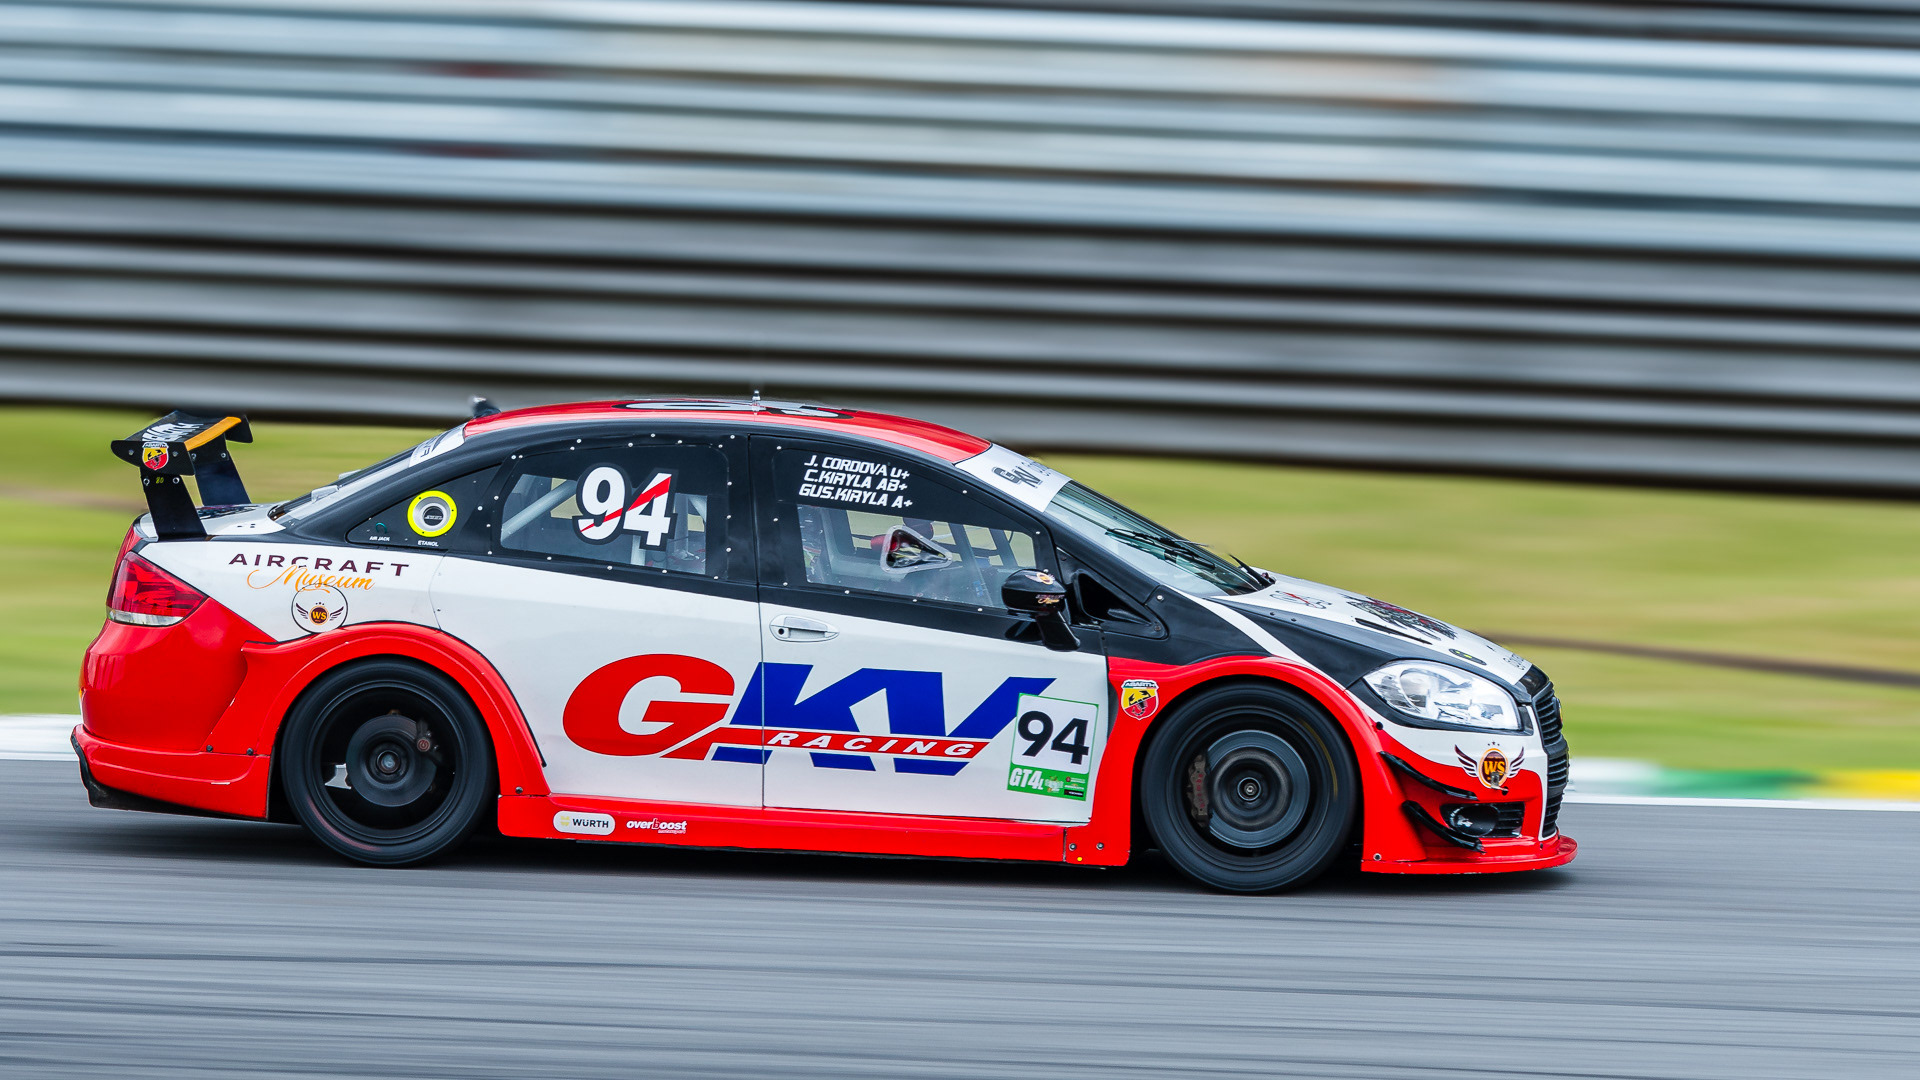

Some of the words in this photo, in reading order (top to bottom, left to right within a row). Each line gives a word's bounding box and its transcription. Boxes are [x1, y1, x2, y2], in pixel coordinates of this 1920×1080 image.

[804, 454, 819, 467] J.
[821, 456, 888, 477] CORDOVA
[803, 469, 872, 489] C.KIRYLA
[577, 466, 672, 547] 94
[798, 483, 889, 507] GUS.KIRYLA
[891, 495, 914, 509] A+
[228, 553, 410, 577] AIRCRAFT
[246, 564, 376, 594] Museum
[312, 610, 328, 621] WS
[562, 653, 1057, 777] GKV
[767, 731, 976, 757] RACING
[1017, 710, 1090, 765] 94
[1483, 760, 1506, 776] WS
[572, 818, 609, 829] WÜRTH
[626, 817, 688, 831] overboost
